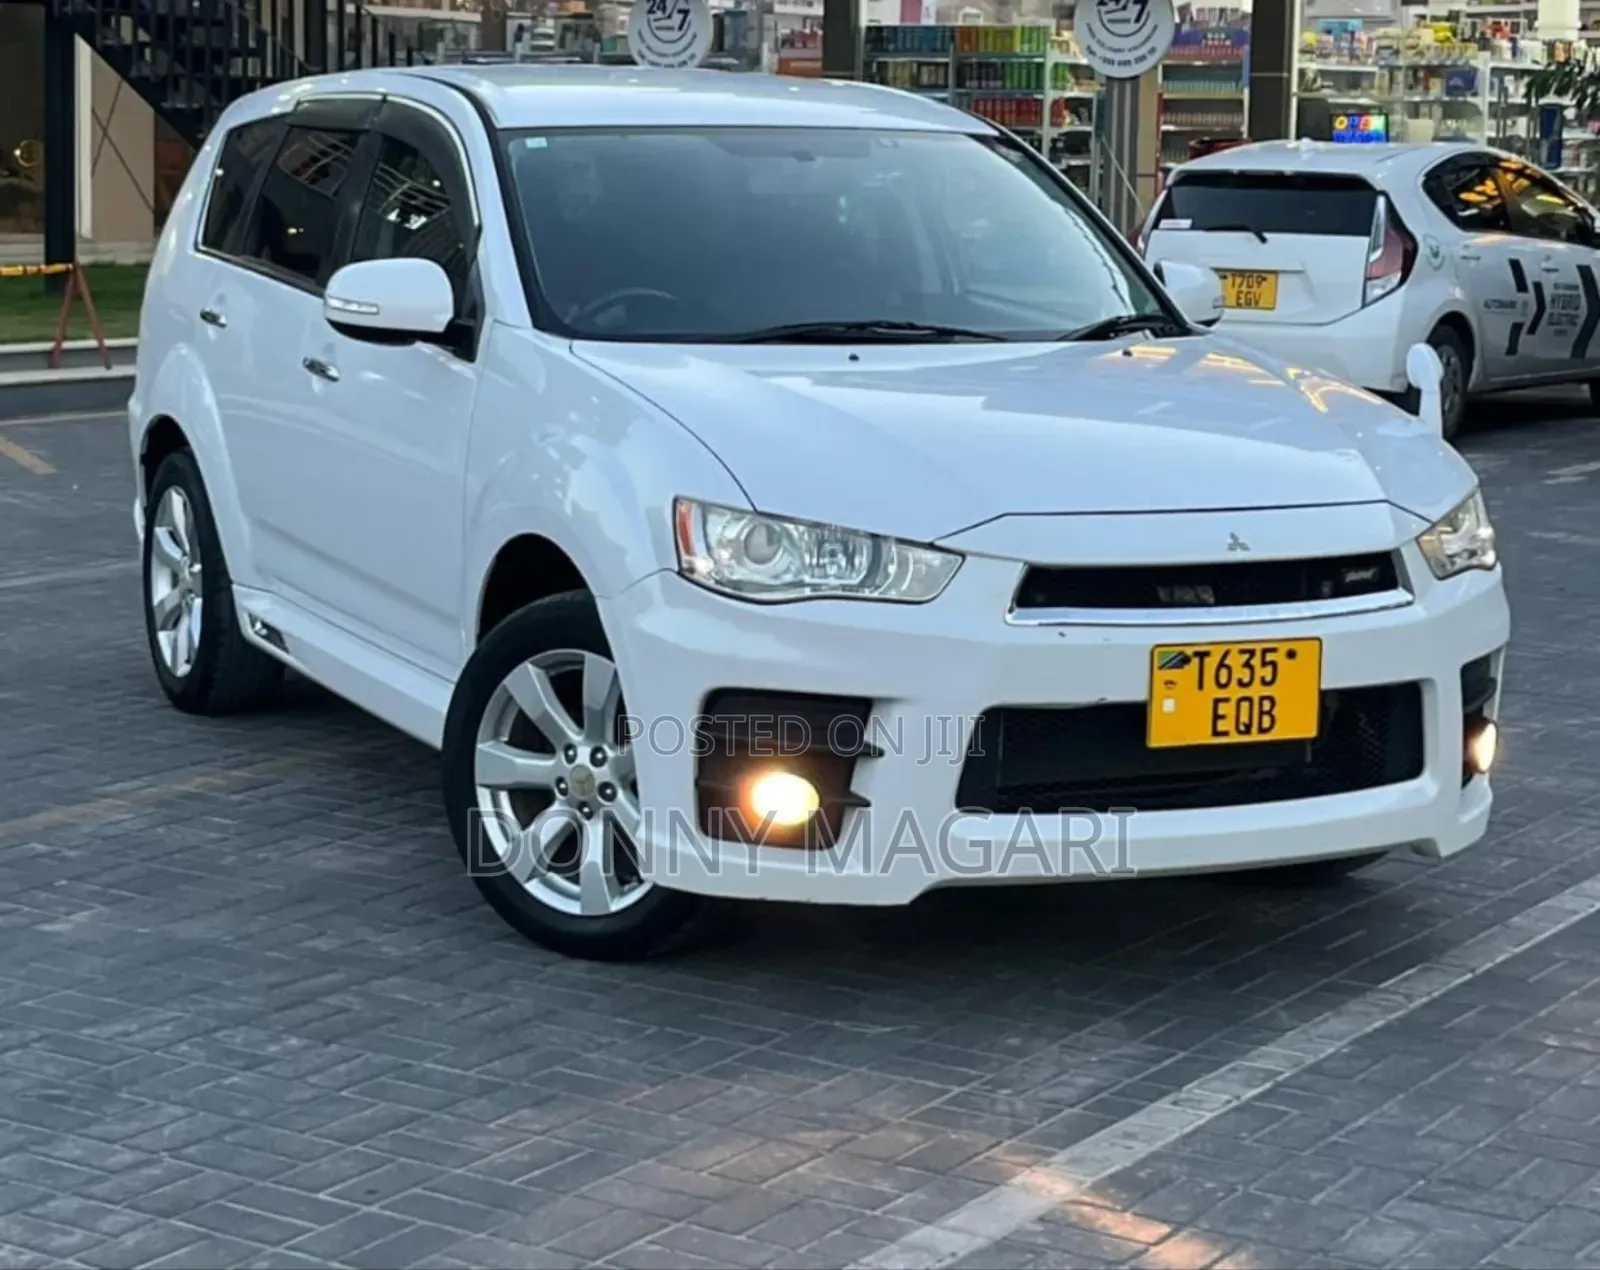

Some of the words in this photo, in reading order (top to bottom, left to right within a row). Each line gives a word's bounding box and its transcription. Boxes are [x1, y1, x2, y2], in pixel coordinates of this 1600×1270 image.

[646, 0, 691, 32] 24/7
[1236, 290, 1262, 306] EGV
[1193, 647, 1279, 691] T635
[1211, 694, 1276, 737] EQB
